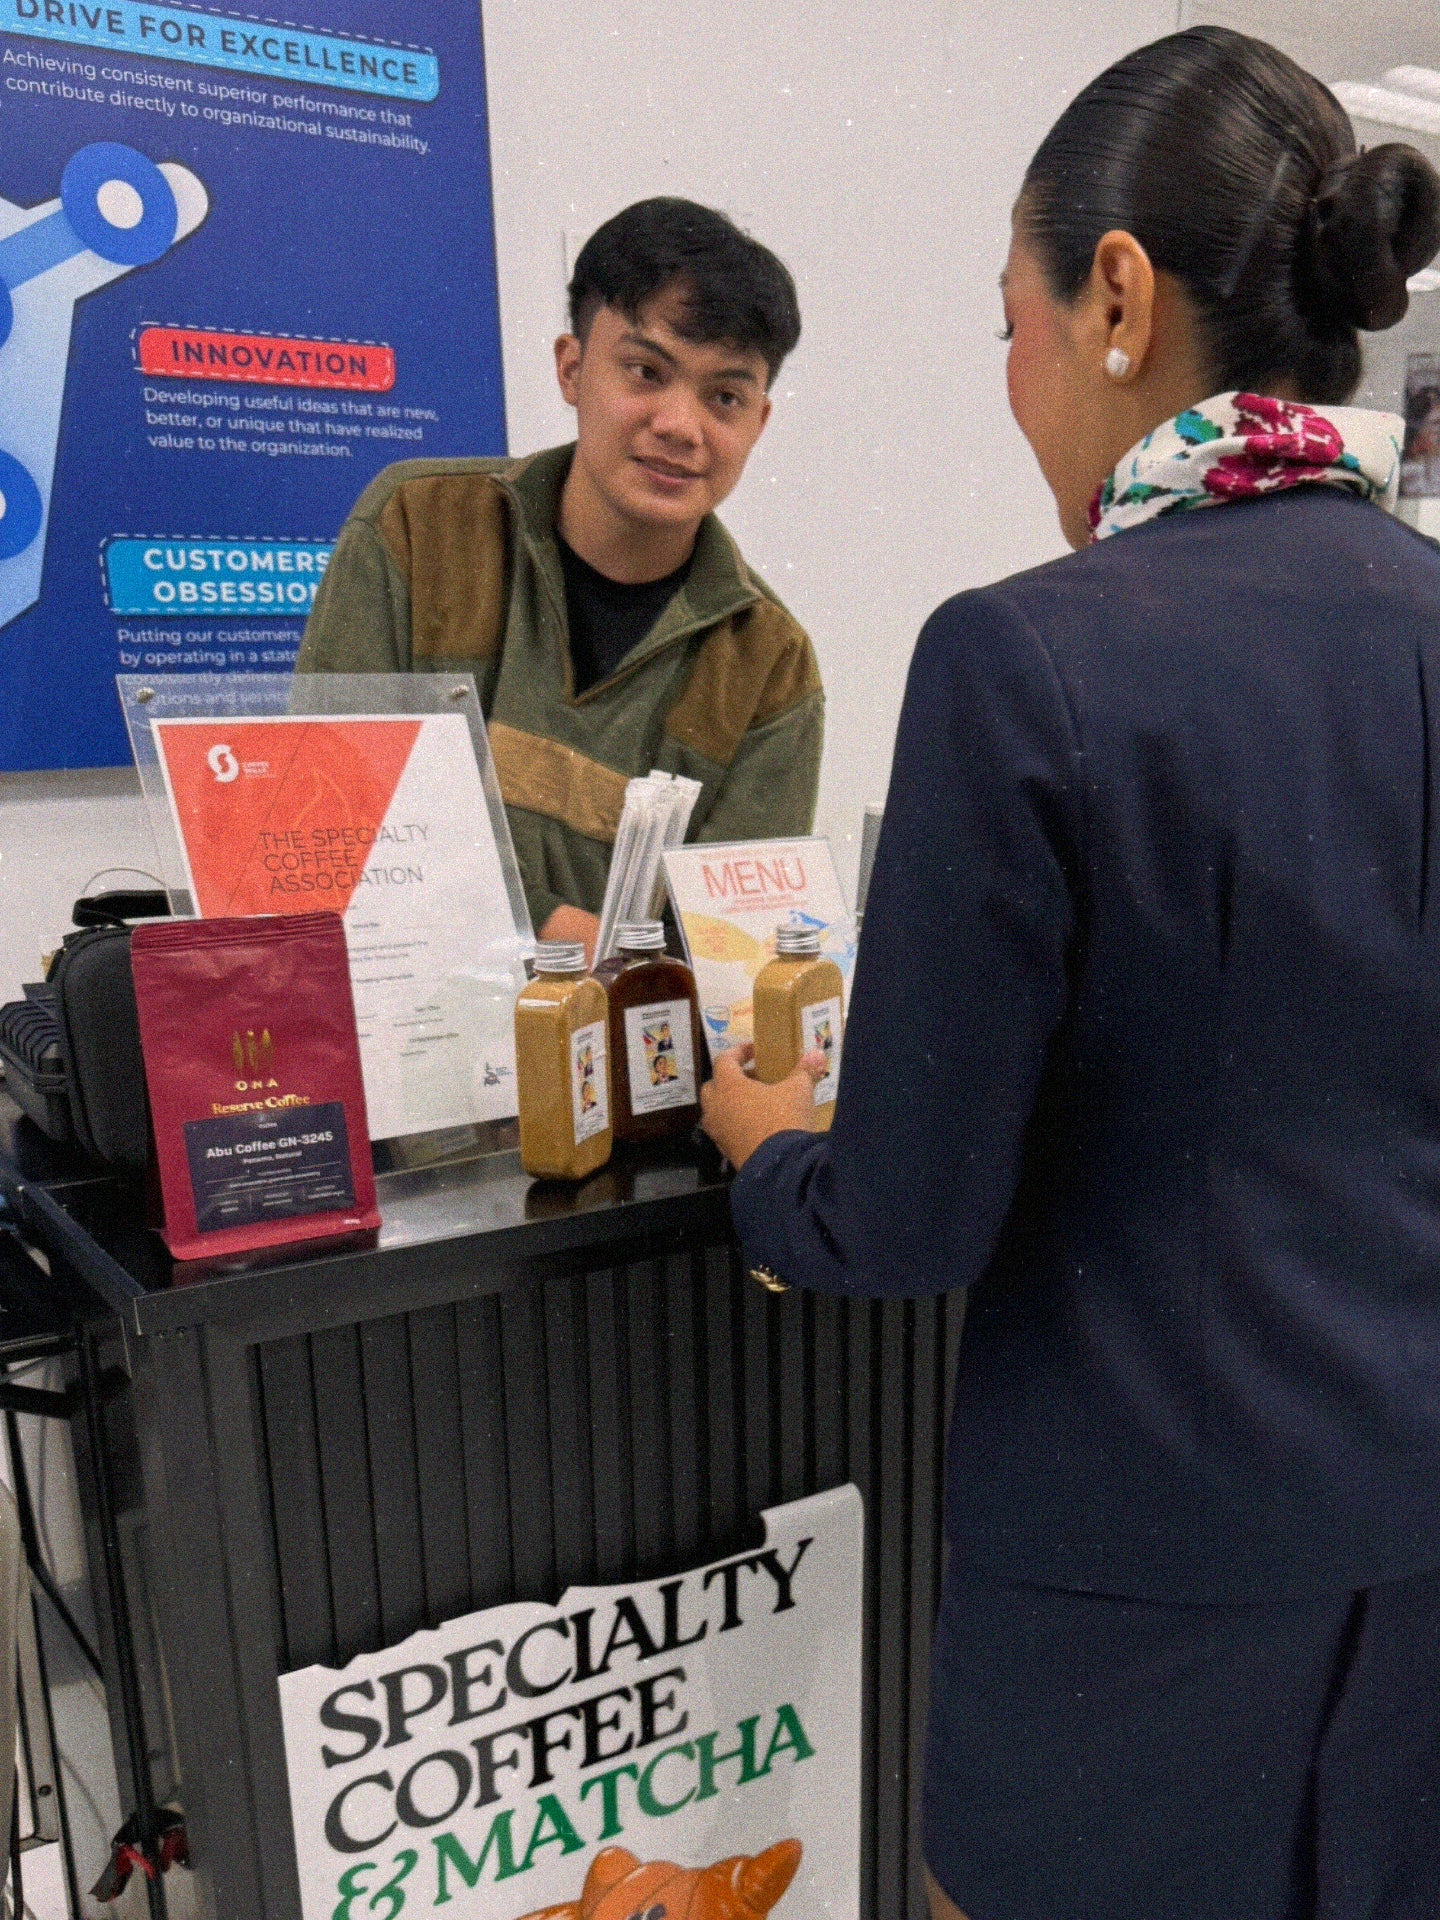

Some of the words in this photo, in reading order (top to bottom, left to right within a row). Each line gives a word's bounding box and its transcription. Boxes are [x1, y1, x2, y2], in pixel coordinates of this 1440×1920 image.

[16, 0, 125, 34] DRIVE
[140, 15, 206, 48] FOR
[221, 29, 418, 85] EXCELLENCE
[3, 49, 96, 80] Achieving
[102, 66, 194, 93] consistent
[199, 81, 268, 108] superior
[272, 93, 377, 122] performance
[380, 108, 413, 128] that
[6, 76, 105, 103] contribute
[110, 90, 176, 117] directly
[181, 101, 199, 117] to
[203, 104, 322, 136] organizational
[325, 124, 432, 155] sustainability.
[172, 340, 367, 376] INNOVATION
[143, 387, 241, 411] Developing
[244, 394, 294, 411] useful
[297, 398, 339, 414] ideas
[342, 401, 373, 416] that
[376, 405, 401, 418] are
[404, 407, 440, 422] new,
[145, 409, 203, 428] better,
[206, 416, 223, 428] or
[227, 417, 286, 434] unique
[288, 418, 321, 435] that
[324, 420, 362, 437] have
[365, 423, 424, 441] realized
[147, 433, 195, 449] value
[198, 436, 216, 450] to
[218, 436, 248, 451] the
[251, 439, 353, 457] organization.
[117, 628, 182, 646] Putting
[185, 630, 213, 643] our
[217, 629, 300, 643] customers
[120, 650, 142, 669] by
[144, 651, 226, 667] operating
[229, 650, 245, 663] in
[248, 652, 258, 663] a
[259, 830, 304, 849] THE
[312, 824, 429, 848] SPECIALTY
[264, 850, 358, 872] COFFEE
[270, 866, 424, 895] ASSOCIATION
[702, 857, 808, 898] MENU
[235, 1077, 279, 1091] ONA
[211, 1099, 264, 1114] Reserve
[264, 1093, 311, 1109] Coffee
[206, 1146, 233, 1159] Abu
[235, 1138, 276, 1155] Coffee
[278, 1130, 334, 1148] GN-3245
[319, 1536, 816, 1769] SPECIALTY
[323, 1666, 690, 1854] COFFEE
[331, 1849, 419, 1920] &
[430, 1702, 817, 1907] MATCHA
